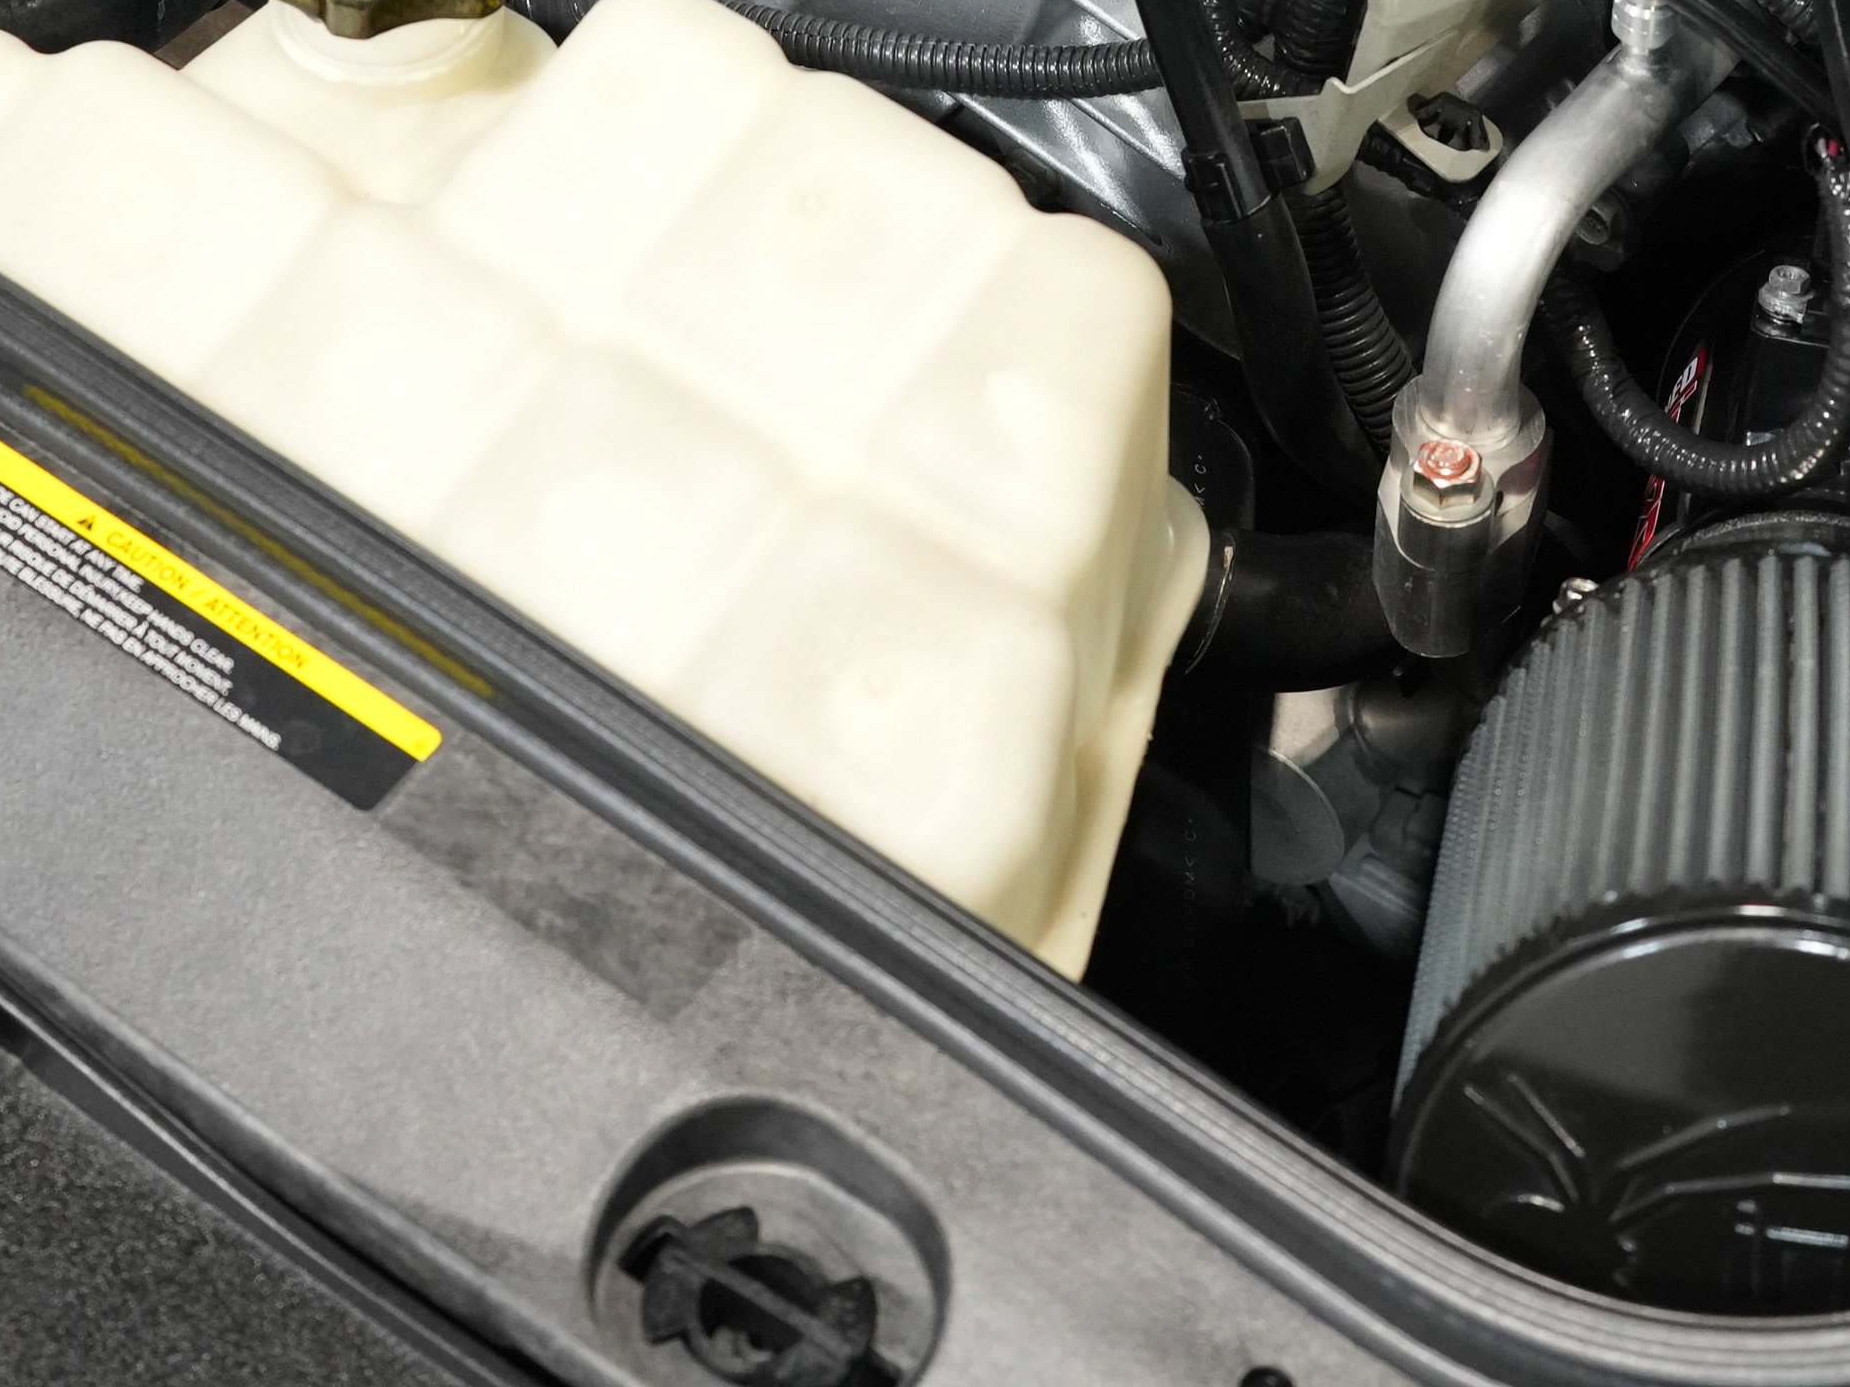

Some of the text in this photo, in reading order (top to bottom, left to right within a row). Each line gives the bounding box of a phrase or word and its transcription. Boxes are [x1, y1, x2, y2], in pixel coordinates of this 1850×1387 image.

[8, 496, 39, 522] CAN
[34, 513, 75, 545] START
[69, 538, 90, 556] AT
[85, 548, 116, 573] ANY
[17, 523, 83, 572] PERSONAL
[147, 609, 194, 645] HANDS
[7, 539, 57, 576] RISQUE
[51, 568, 74, 587] DE
[143, 629, 180, 658] TOUT
[106, 528, 187, 592] CAUTION
[204, 597, 308, 671] ATTENTION
[80, 608, 103, 628] NE
[98, 621, 126, 644] PAS
[122, 637, 145, 657] EN
[140, 649, 218, 707] APPROCHER
[212, 698, 242, 722] LES
